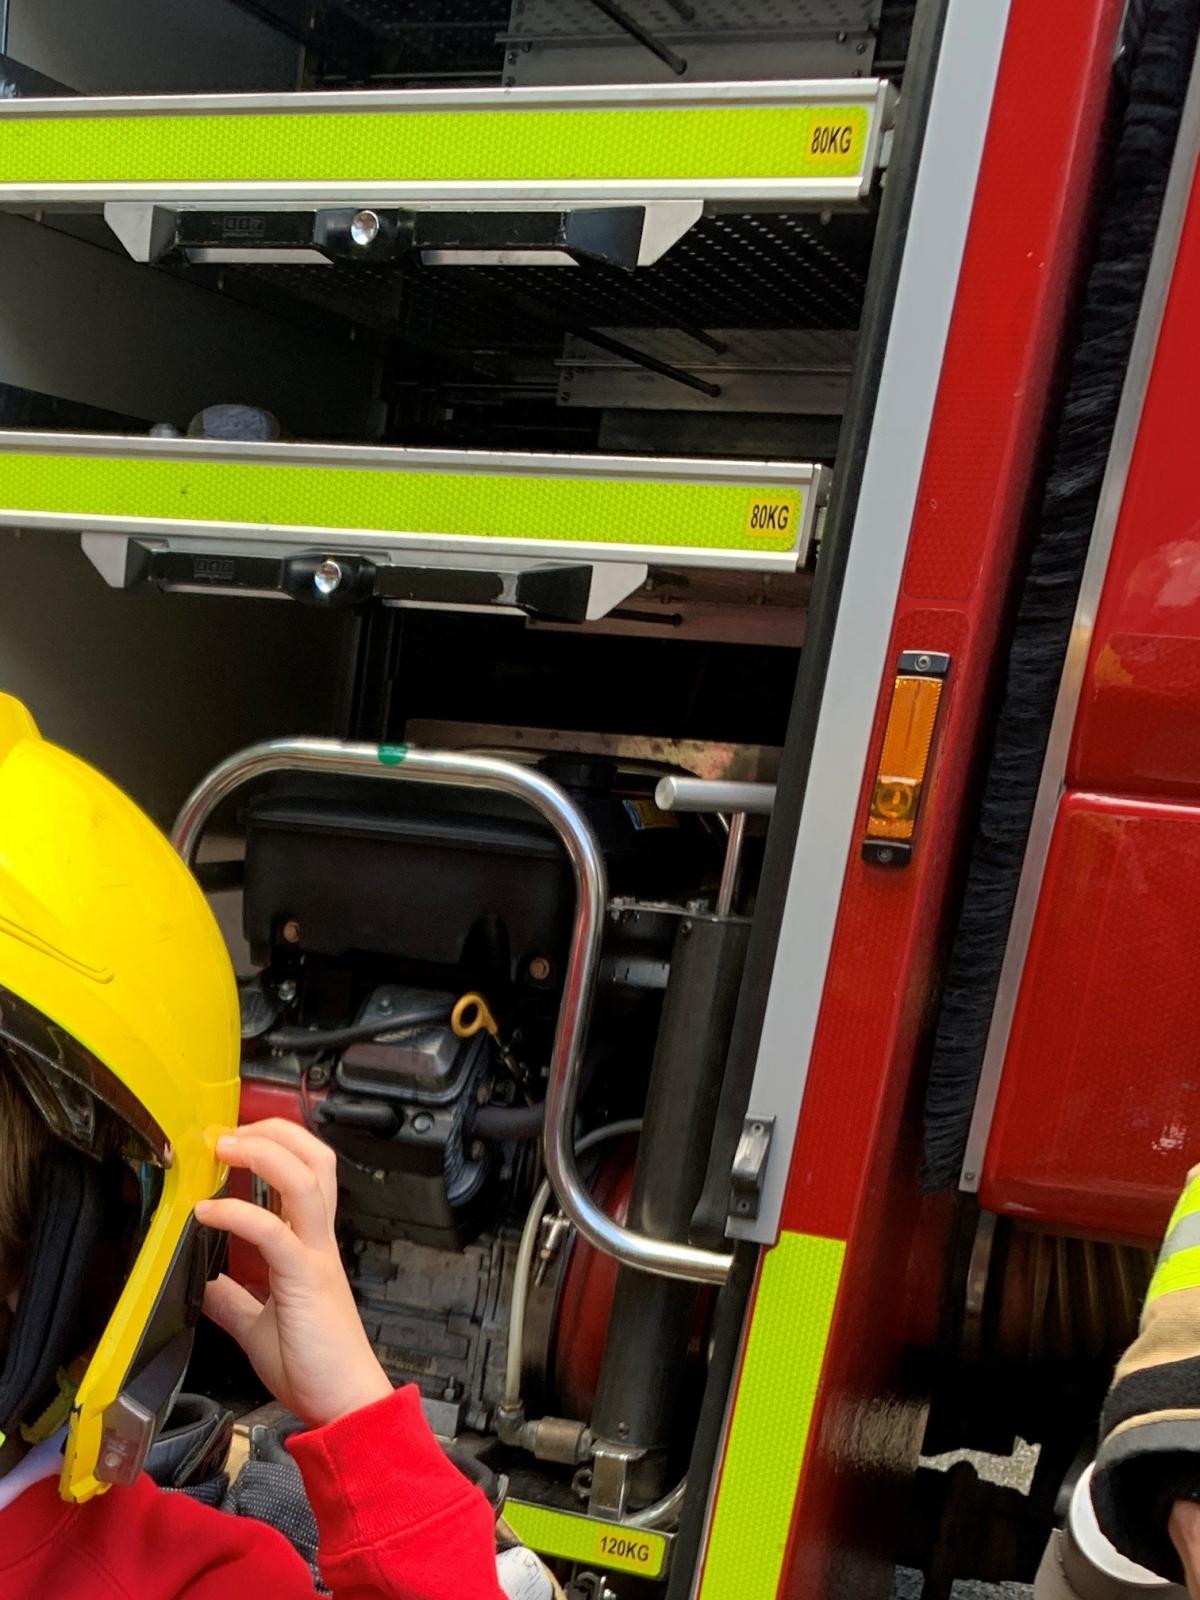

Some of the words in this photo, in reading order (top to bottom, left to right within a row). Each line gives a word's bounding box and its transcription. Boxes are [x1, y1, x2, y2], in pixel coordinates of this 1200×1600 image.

[811, 126, 853, 154] 80KG
[750, 504, 790, 531] 80KG
[601, 1536, 650, 1562] 120KG
